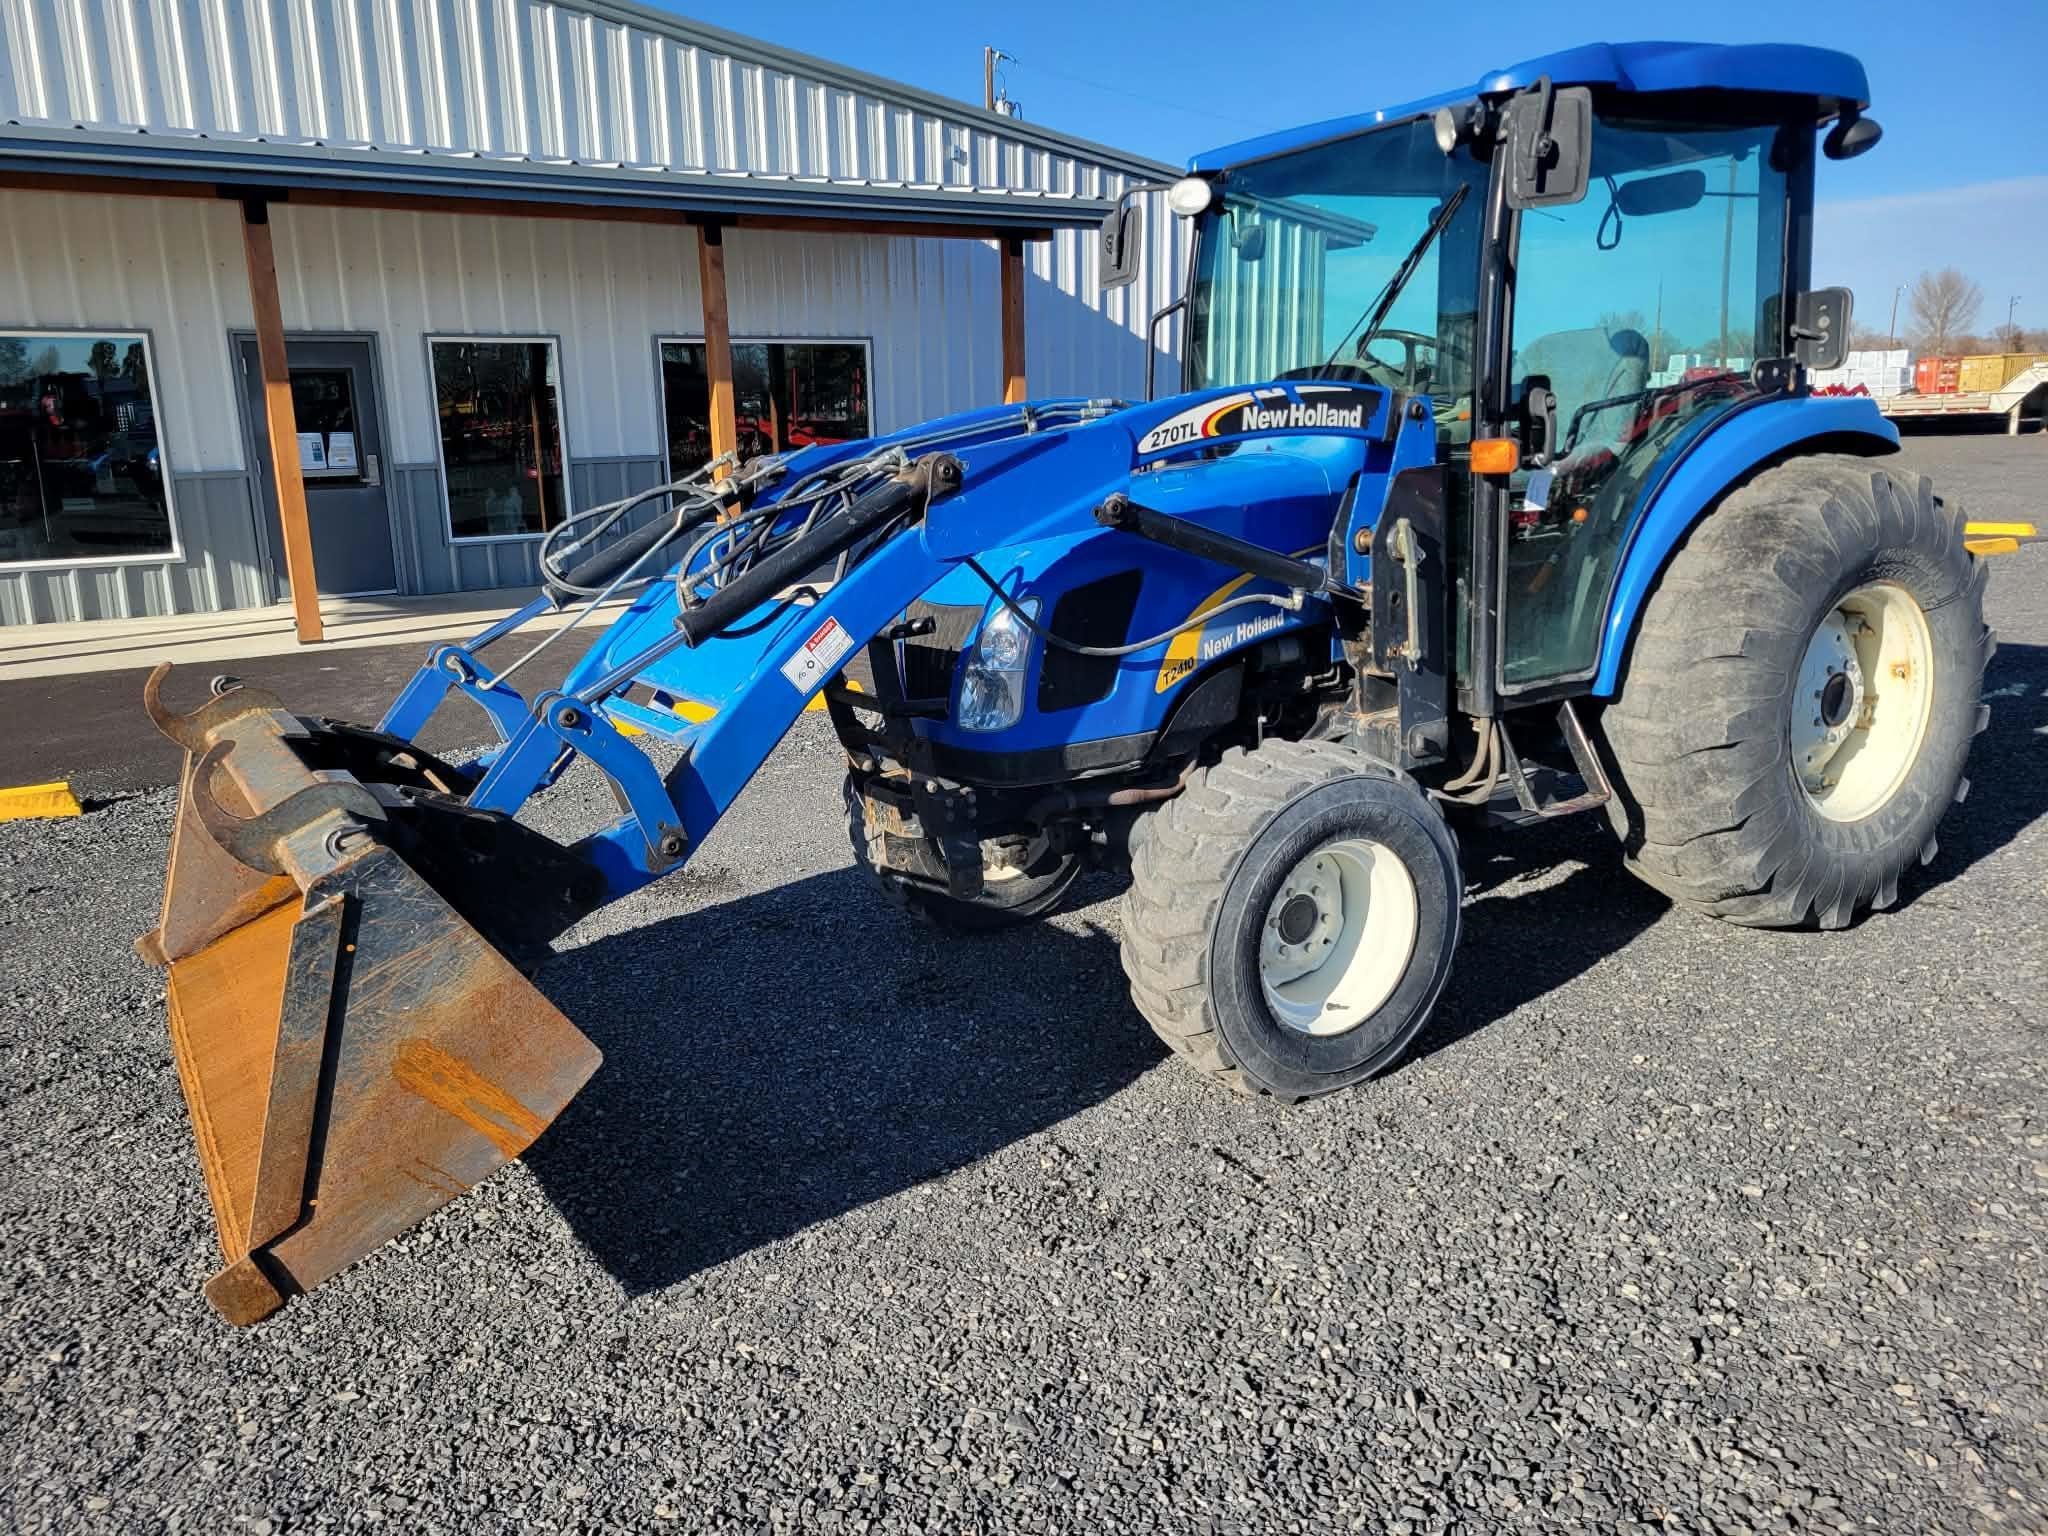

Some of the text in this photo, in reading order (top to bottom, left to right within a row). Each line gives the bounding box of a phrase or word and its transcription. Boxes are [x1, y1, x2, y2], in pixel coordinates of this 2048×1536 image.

[1242, 402, 1362, 431] New Holland
[1151, 423, 1198, 447] 270TL
[1204, 609, 1284, 659] New Holland
